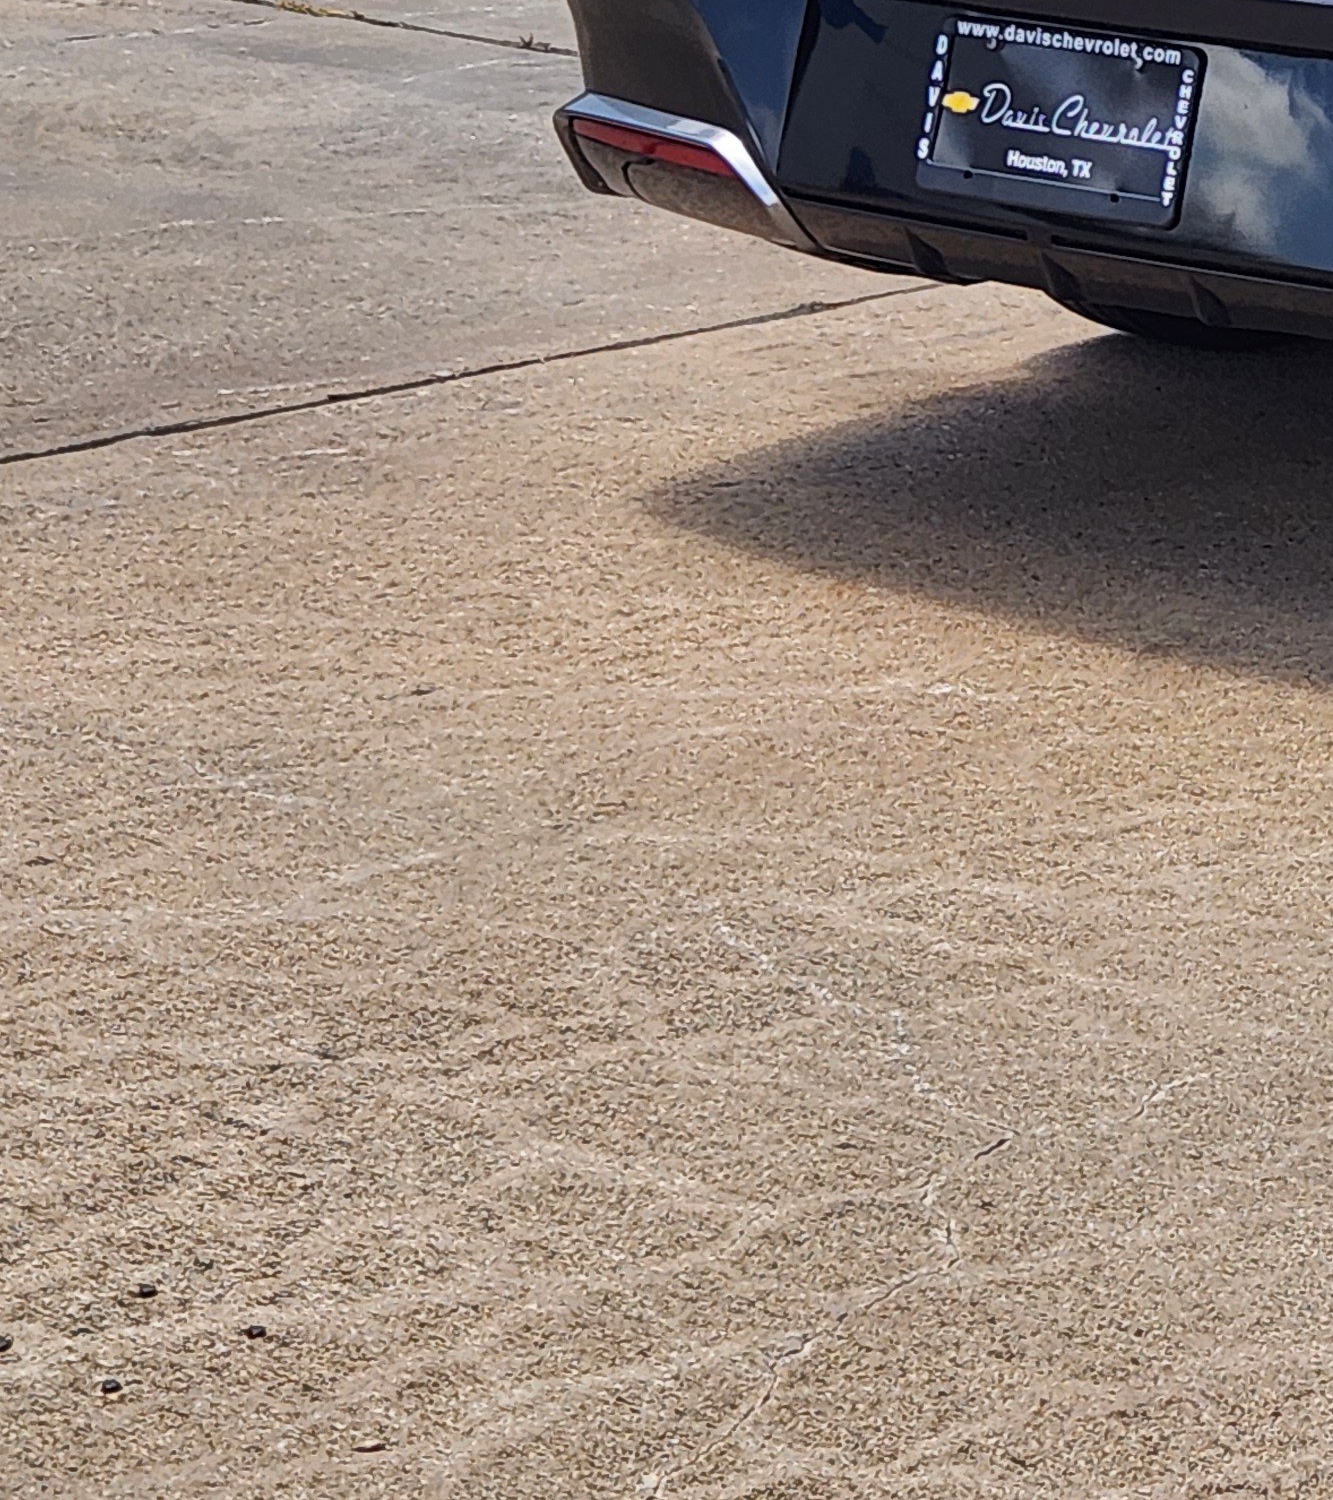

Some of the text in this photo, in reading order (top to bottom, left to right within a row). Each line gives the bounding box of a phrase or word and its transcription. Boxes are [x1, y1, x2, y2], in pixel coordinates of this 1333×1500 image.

[957, 20, 1182, 65] www.davischevrolet.com
[917, 34, 949, 160] DAVIS
[981, 83, 1176, 151] Davis Chevrolet
[1006, 150, 1092, 179] Houston, TX
[1160, 69, 1195, 206] CHEVROLET
